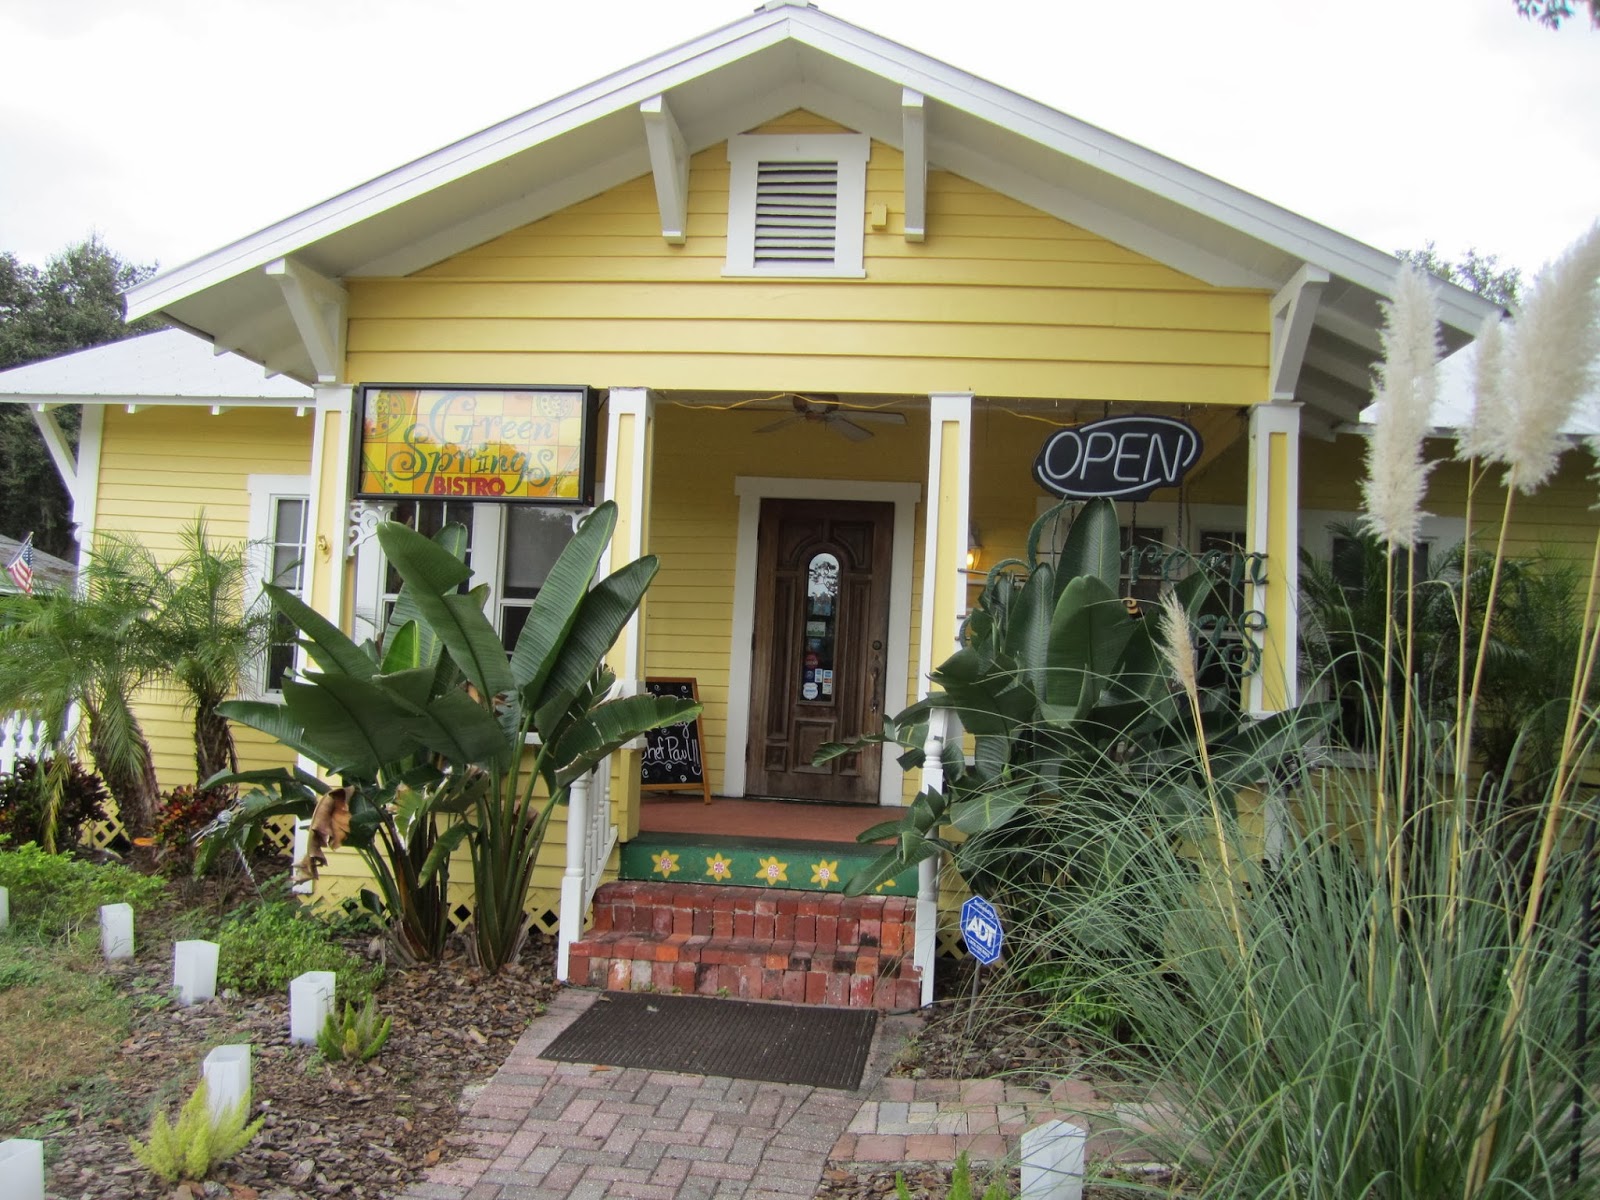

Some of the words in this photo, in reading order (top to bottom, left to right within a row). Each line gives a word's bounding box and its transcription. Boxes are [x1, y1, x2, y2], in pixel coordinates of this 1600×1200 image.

[429, 391, 555, 446] Green
[388, 423, 554, 495] Springs
[1045, 431, 1184, 482] OPEN
[433, 476, 506, 497] BISTRO
[966, 915, 997, 947] ADT
